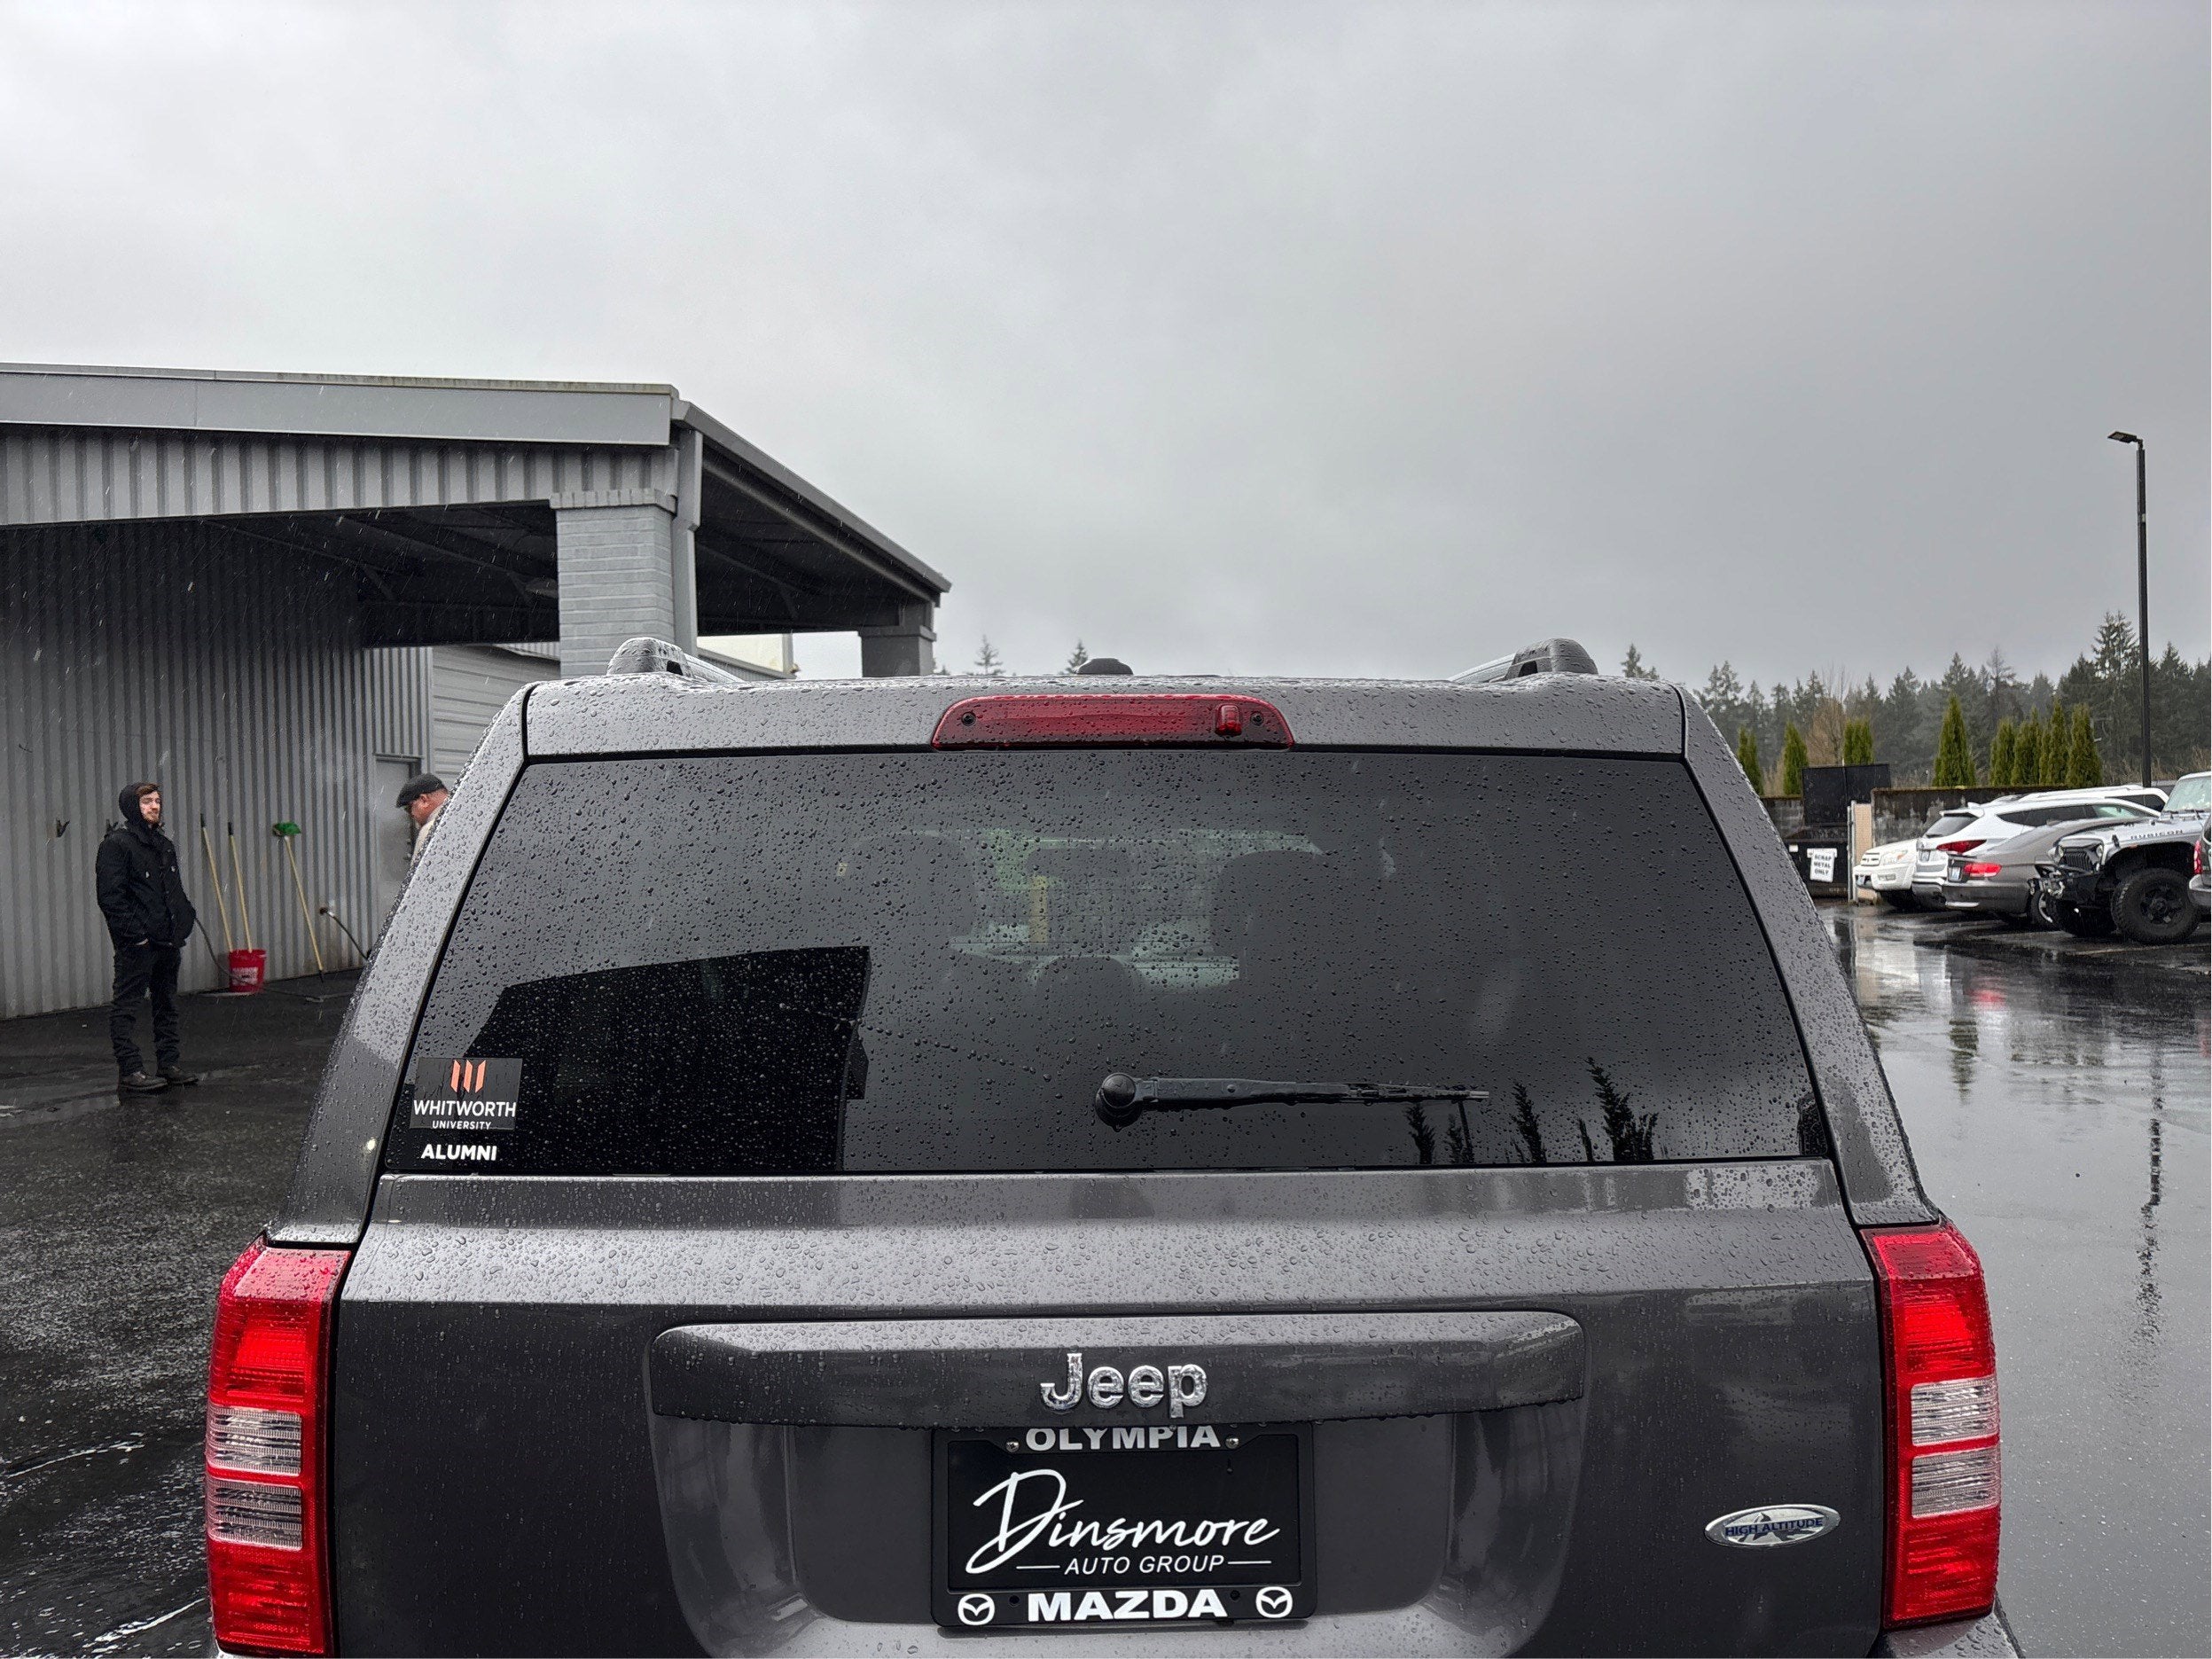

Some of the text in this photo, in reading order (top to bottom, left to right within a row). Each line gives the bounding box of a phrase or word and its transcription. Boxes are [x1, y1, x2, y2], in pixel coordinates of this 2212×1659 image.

[413, 1099, 517, 1117] WHITWORTH
[432, 1120, 492, 1130] UNIVERSITY
[420, 1143, 497, 1161] ALUMNI
[1040, 1352, 1208, 1419] Jeep
[1025, 1425, 1221, 1451] OLYMPIA
[965, 1468, 1281, 1575] Dinsmore
[1724, 1518, 1824, 1537] HIGH ALTITUDE
[1064, 1554, 1225, 1576] AUTO GROUP
[1027, 1589, 1229, 1623] MAZDA
